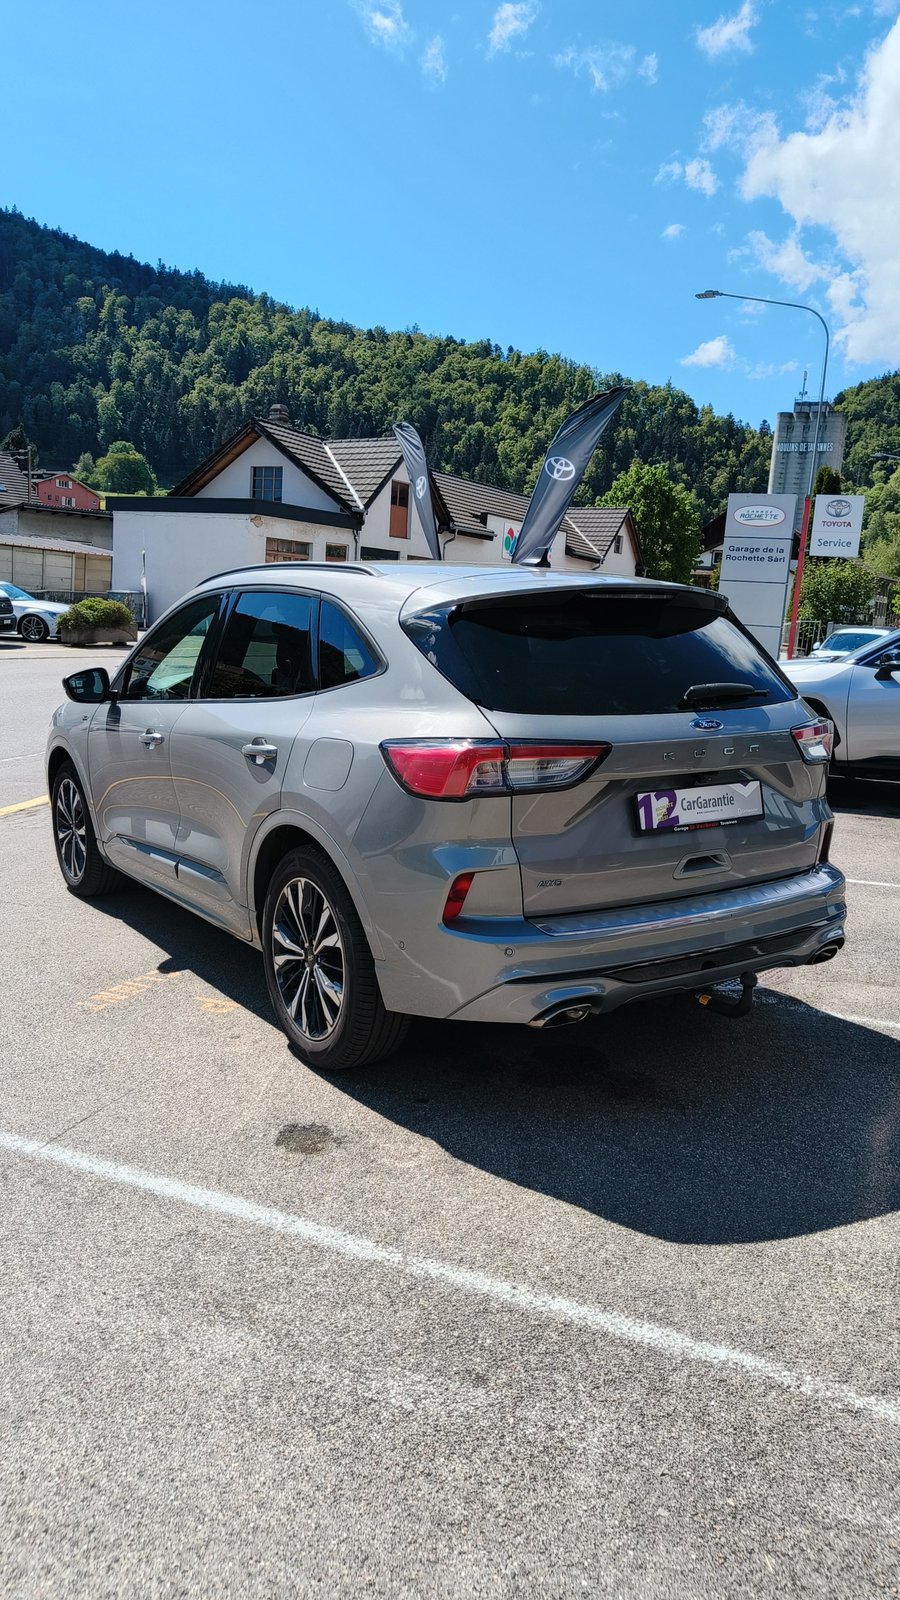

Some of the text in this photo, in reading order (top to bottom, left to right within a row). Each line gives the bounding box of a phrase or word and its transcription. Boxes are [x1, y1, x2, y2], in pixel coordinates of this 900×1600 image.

[799, 442, 808, 452] DE
[808, 442, 834, 452] TAANNES
[822, 520, 852, 528] TOYOTA
[817, 538, 852, 548] Service
[728, 545, 761, 554] Garage
[725, 554, 765, 562] Rochette
[680, 793, 735, 811] CarGarantie
[638, 789, 680, 829] 12
